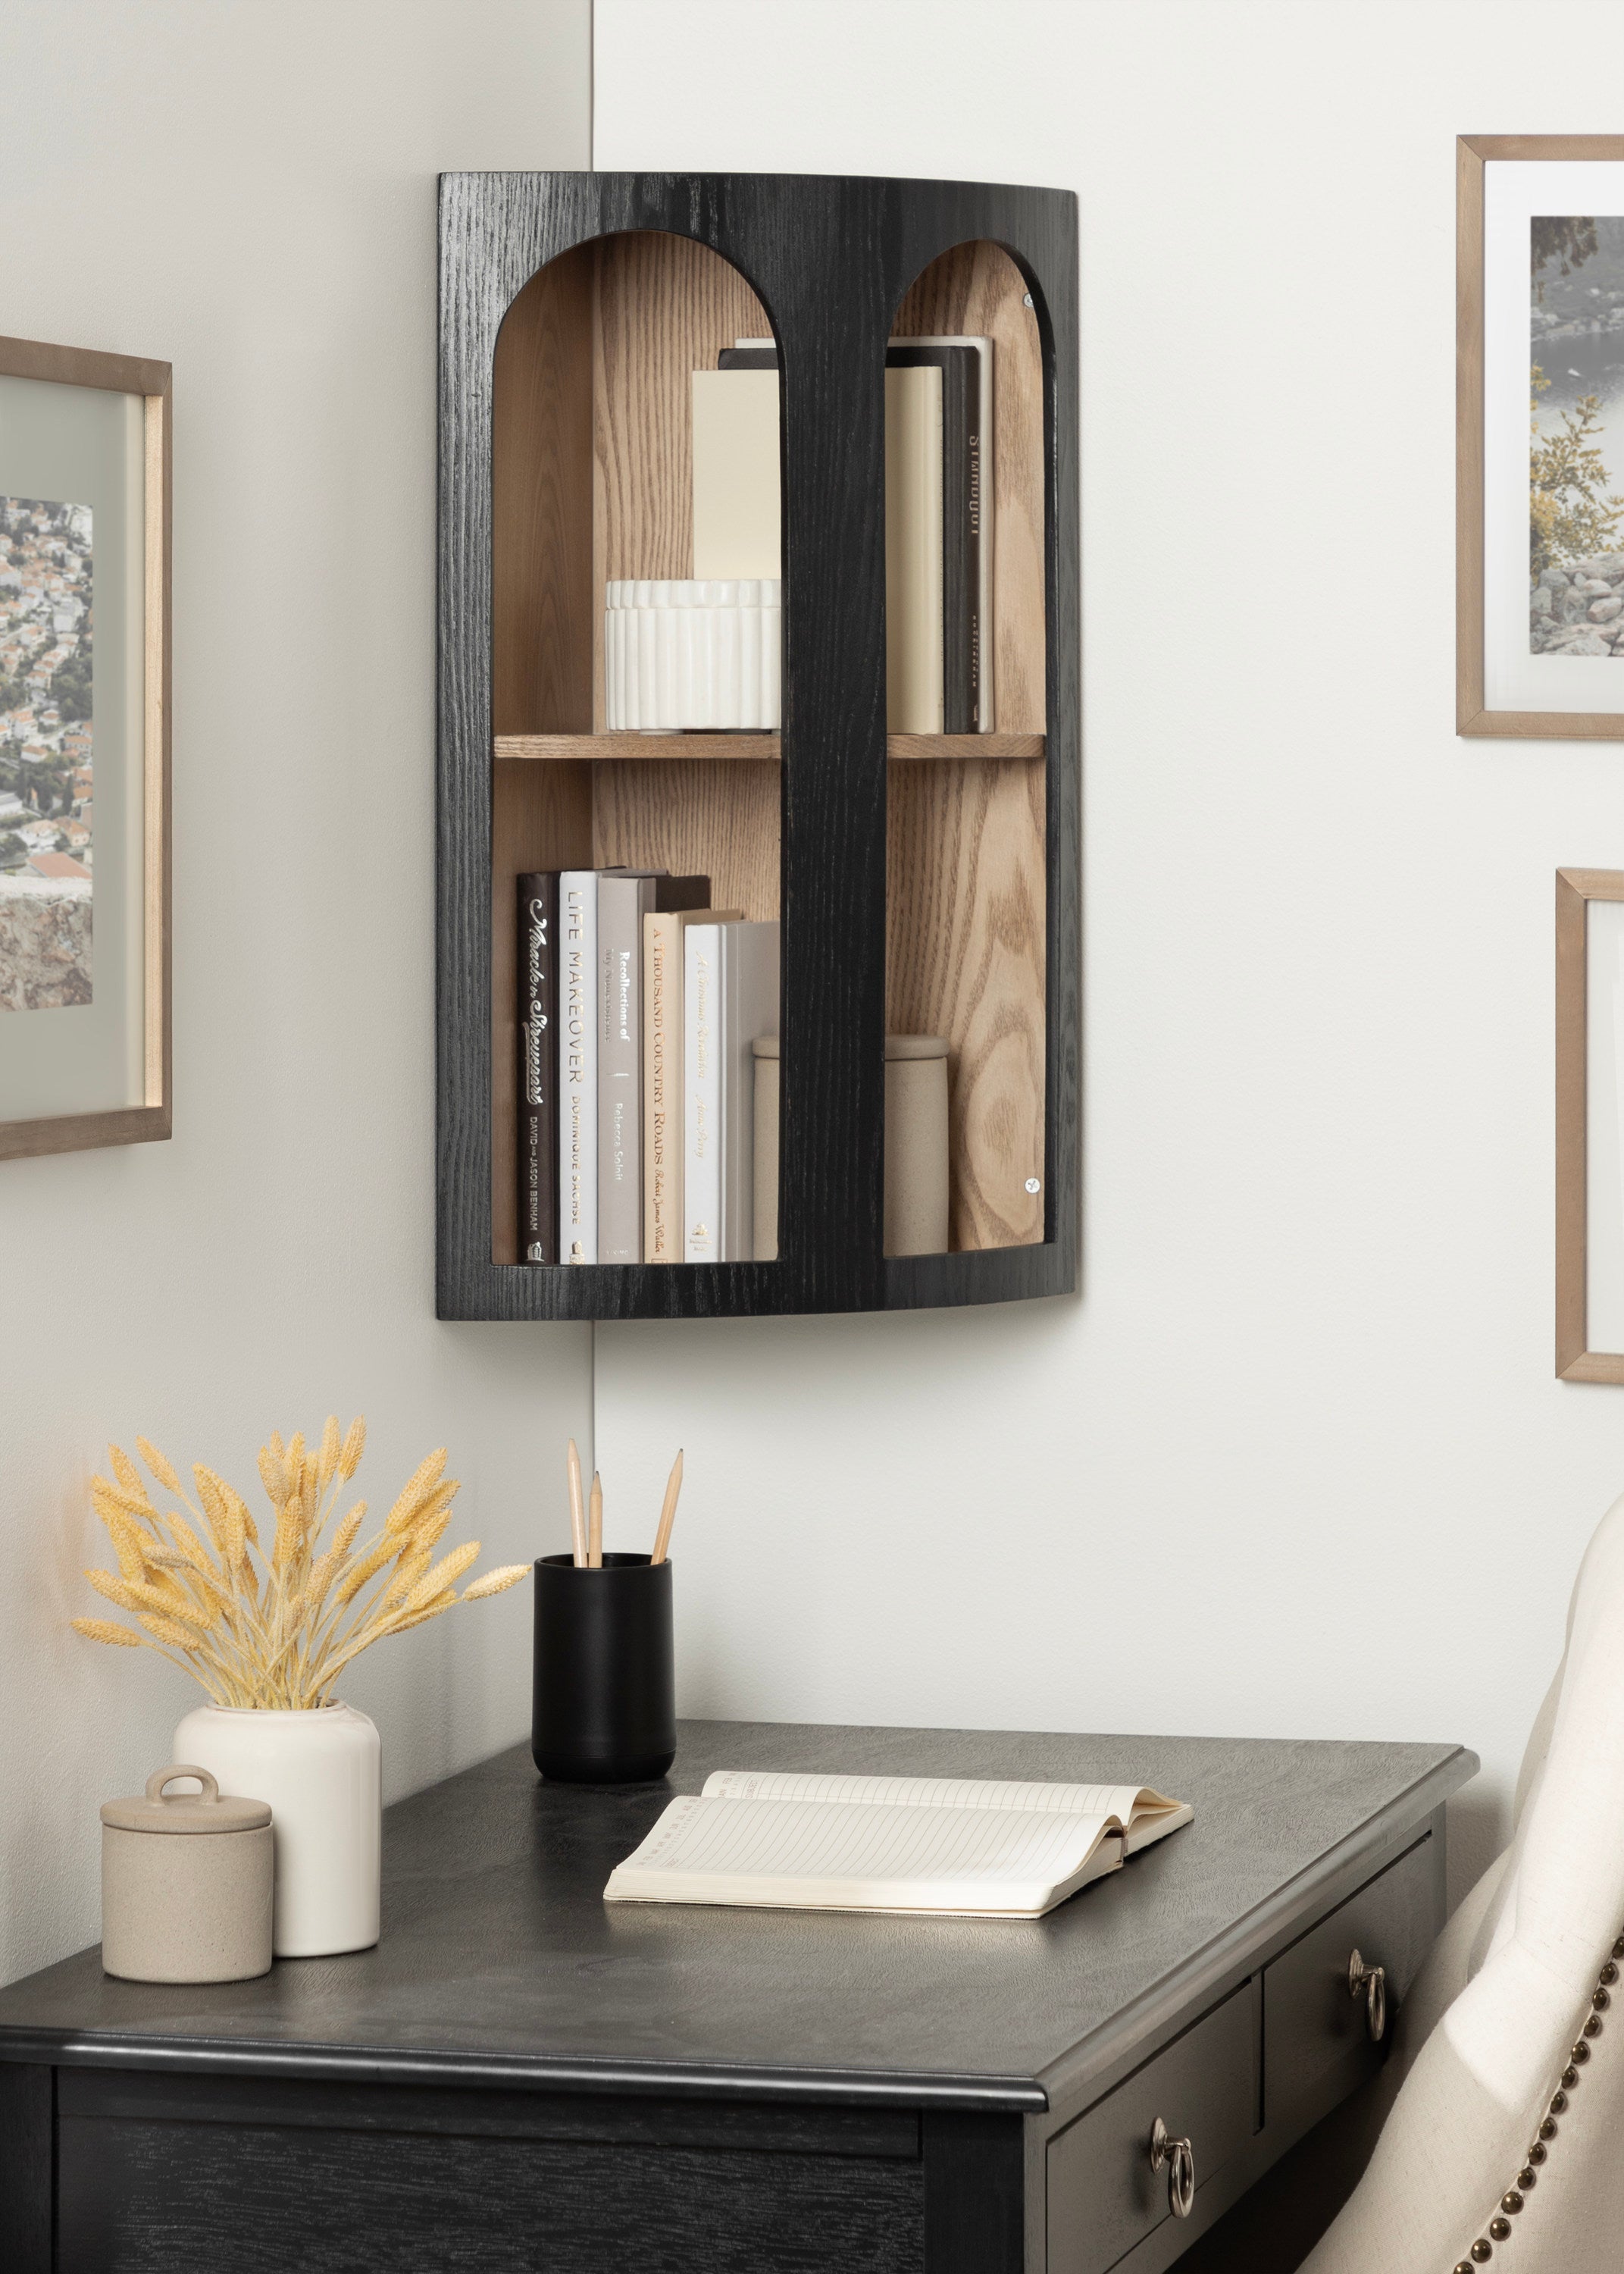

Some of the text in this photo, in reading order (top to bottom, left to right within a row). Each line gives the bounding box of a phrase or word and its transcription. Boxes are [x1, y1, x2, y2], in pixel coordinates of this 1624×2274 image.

[529, 898, 547, 986] Miracle
[568, 891, 584, 1083] LIFE MAKEOVER
[618, 951, 631, 1042] Recollections of
[653, 929, 665, 1165] A THOUSAND COUNTRY ROADS
[530, 1117, 538, 1145] DAVID
[571, 1095, 582, 1226] DOMINIQUE SACHSE
[613, 1103, 623, 1181] Rebecca Solnit
[530, 1157, 538, 1189] JASON
[655, 1170, 665, 1198] Robert
[530, 1190, 538, 1231] BENHAM
[652, 1198, 664, 1223] James
[655, 1224, 665, 1253] Waller
